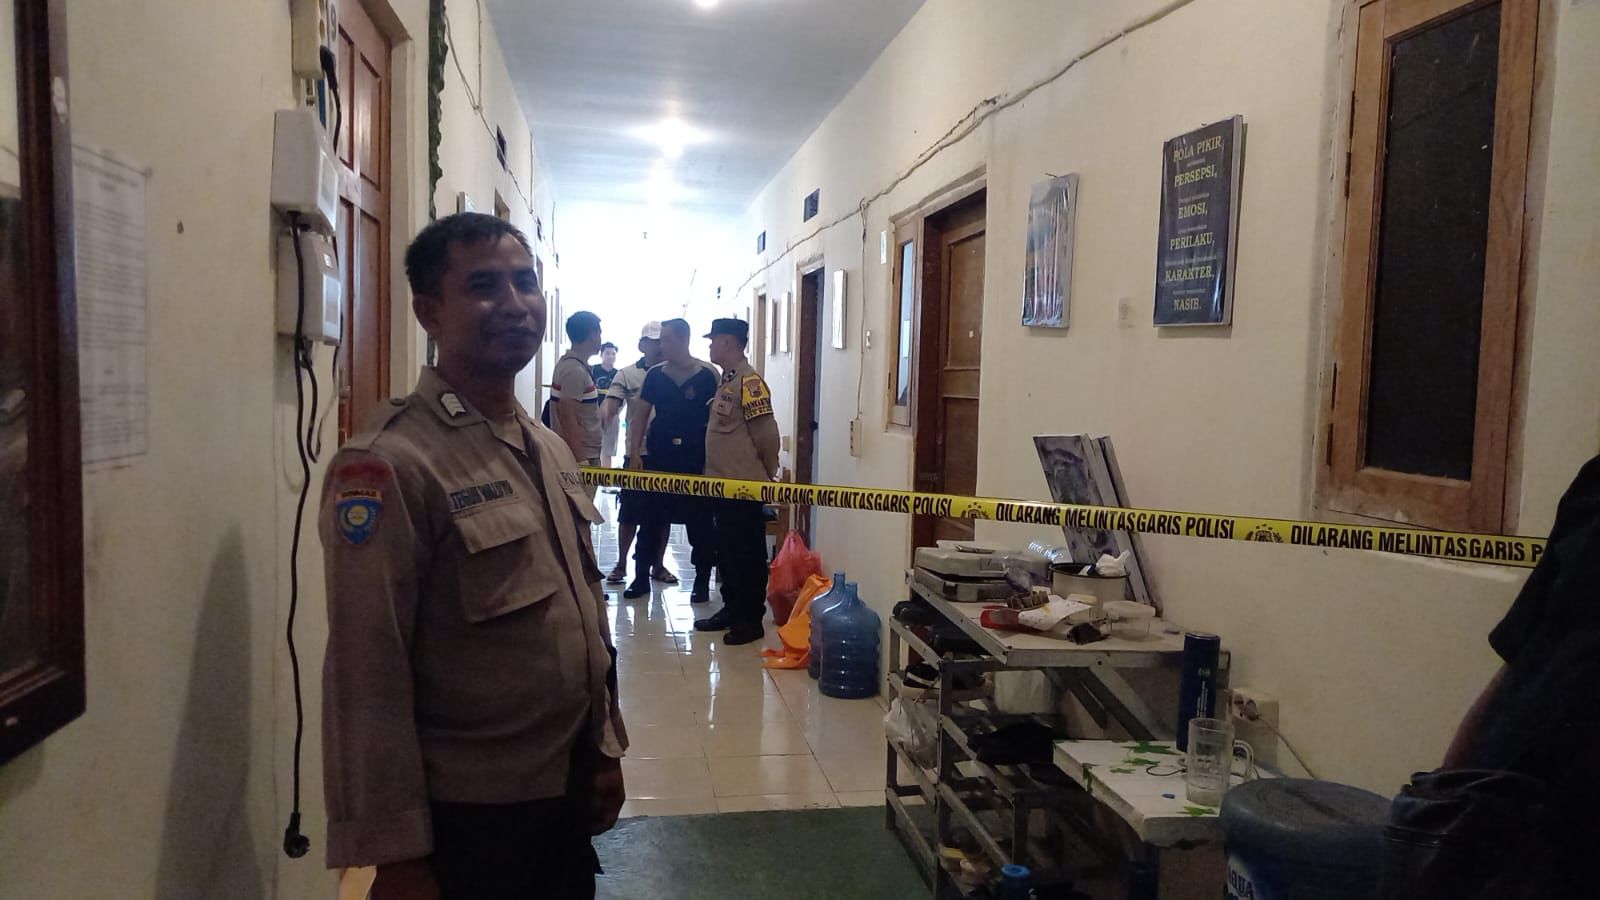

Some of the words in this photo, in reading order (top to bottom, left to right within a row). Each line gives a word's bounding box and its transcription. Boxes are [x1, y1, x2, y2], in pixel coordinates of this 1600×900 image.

[1173, 144, 1194, 162] POLA
[1196, 136, 1222, 154] PIKIR
[1174, 164, 1217, 187] PERSEPSI,
[1178, 202, 1208, 219] EMOSI,
[1170, 232, 1215, 251] PERILAKU,
[1165, 265, 1215, 282] KARAKTER,
[1174, 298, 1202, 312] NASIB.
[761, 486, 813, 505] DILARANG
[913, 496, 952, 518] POLISI
[996, 503, 1061, 526] DILARANG
[1185, 516, 1236, 540] POLISI
[1291, 525, 1374, 550] DILARANG
